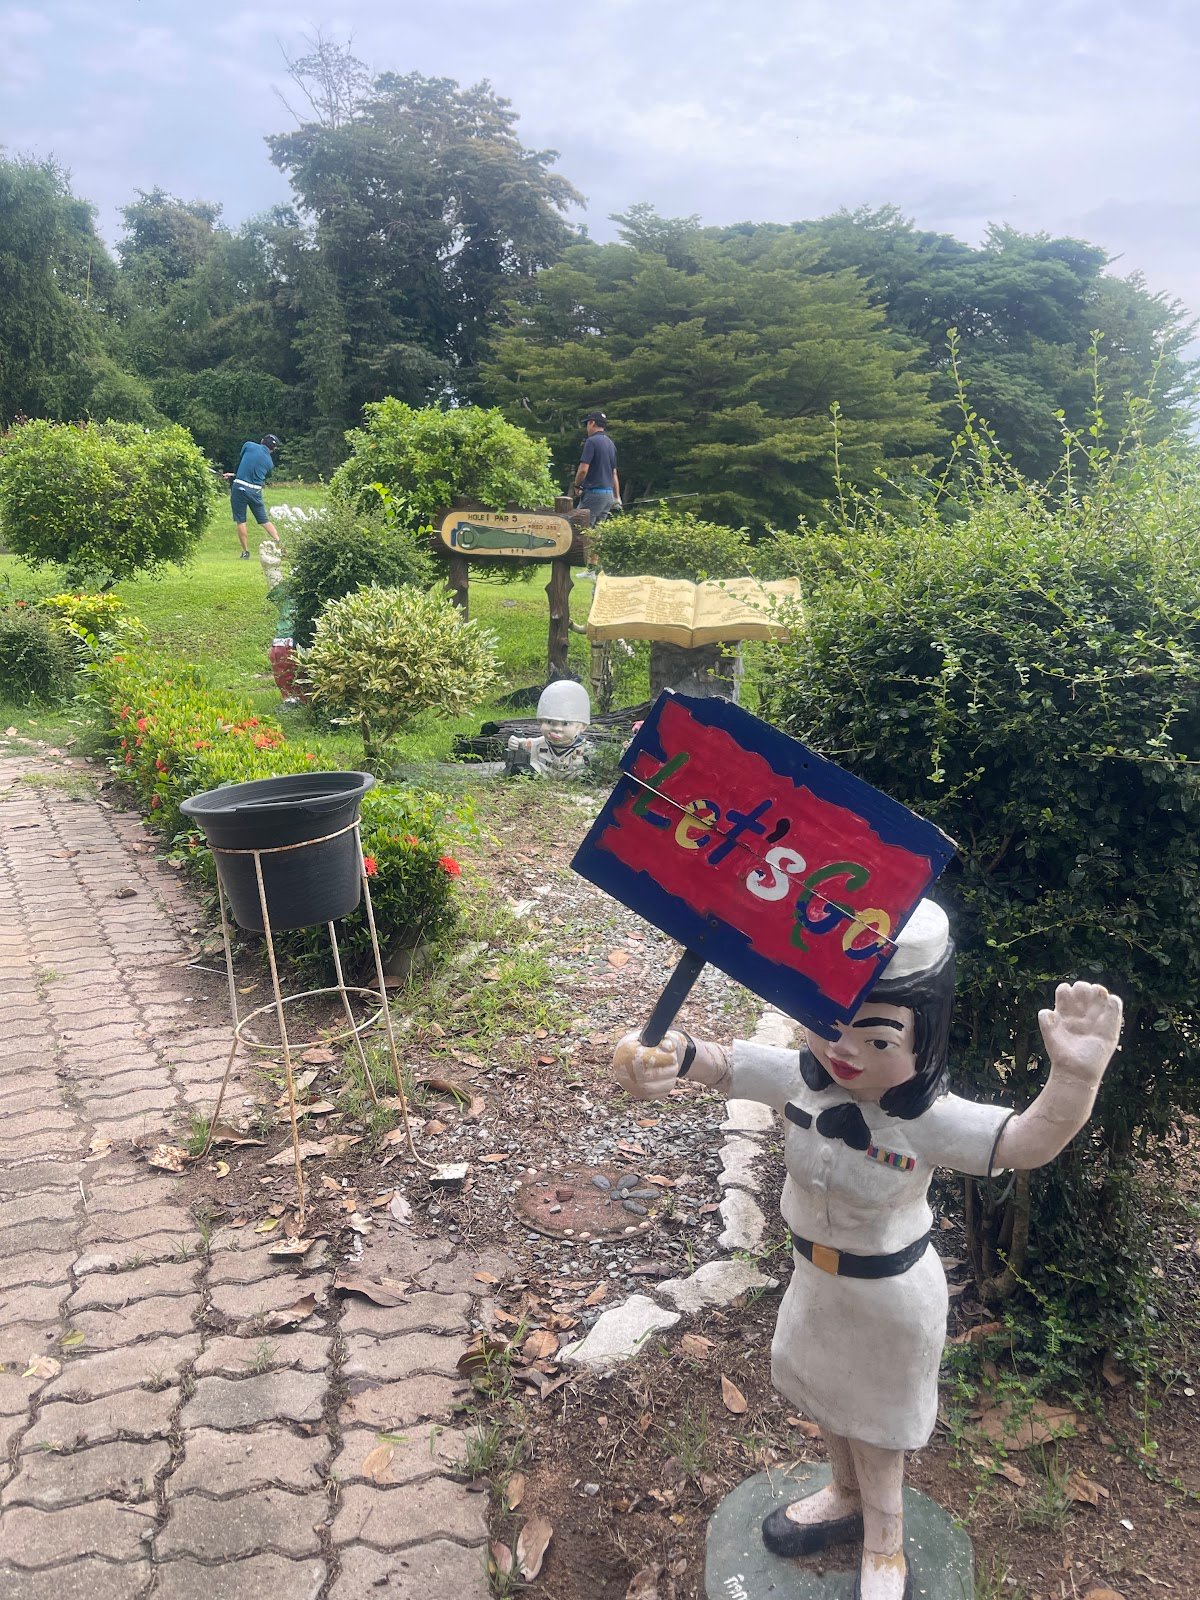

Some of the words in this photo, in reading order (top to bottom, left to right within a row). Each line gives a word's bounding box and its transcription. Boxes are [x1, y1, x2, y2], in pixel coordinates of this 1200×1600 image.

[467, 513, 485, 521] HOLE
[494, 514, 509, 522] PAR
[511, 514, 518, 523] 5
[631, 751, 808, 903] Let's
[790, 860, 892, 962] Go
